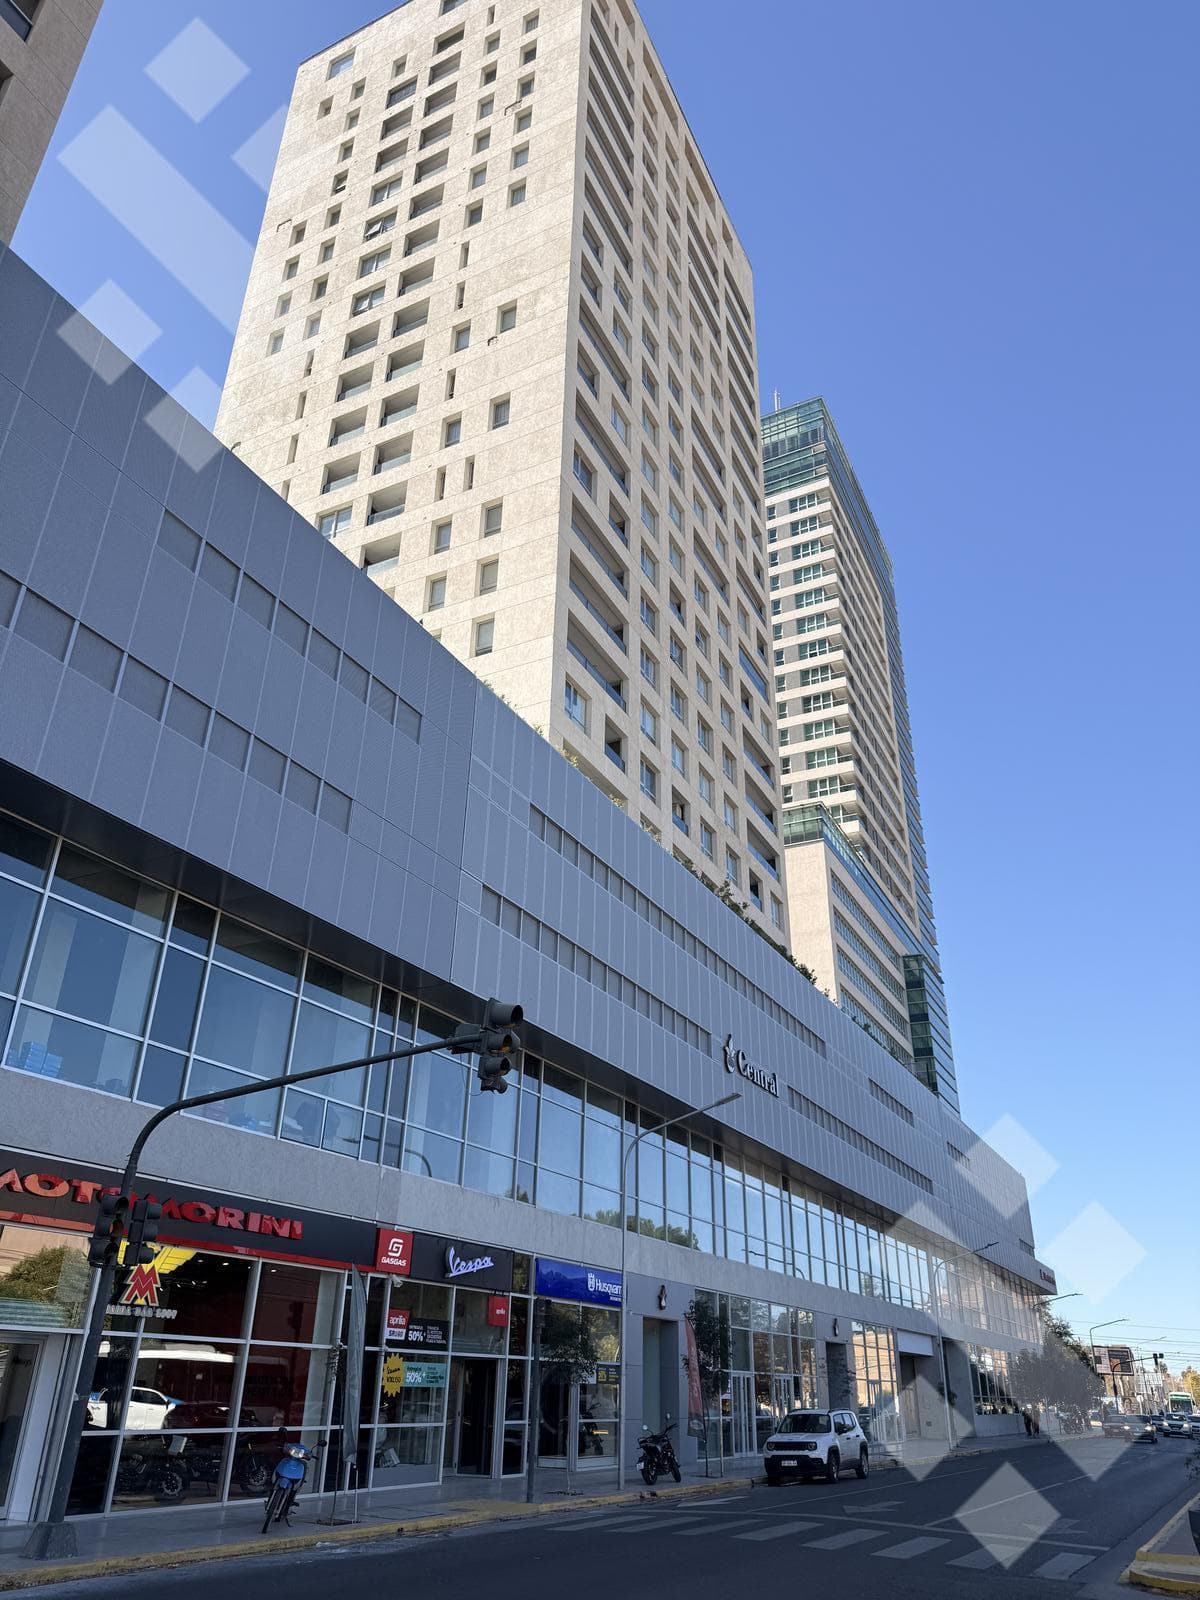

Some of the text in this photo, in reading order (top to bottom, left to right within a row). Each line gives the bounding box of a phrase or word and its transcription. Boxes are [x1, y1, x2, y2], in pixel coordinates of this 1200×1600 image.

[737, 1050, 779, 1098] Central
[381, 1256, 406, 1267] GASGAS
[448, 1246, 494, 1277] Vespa
